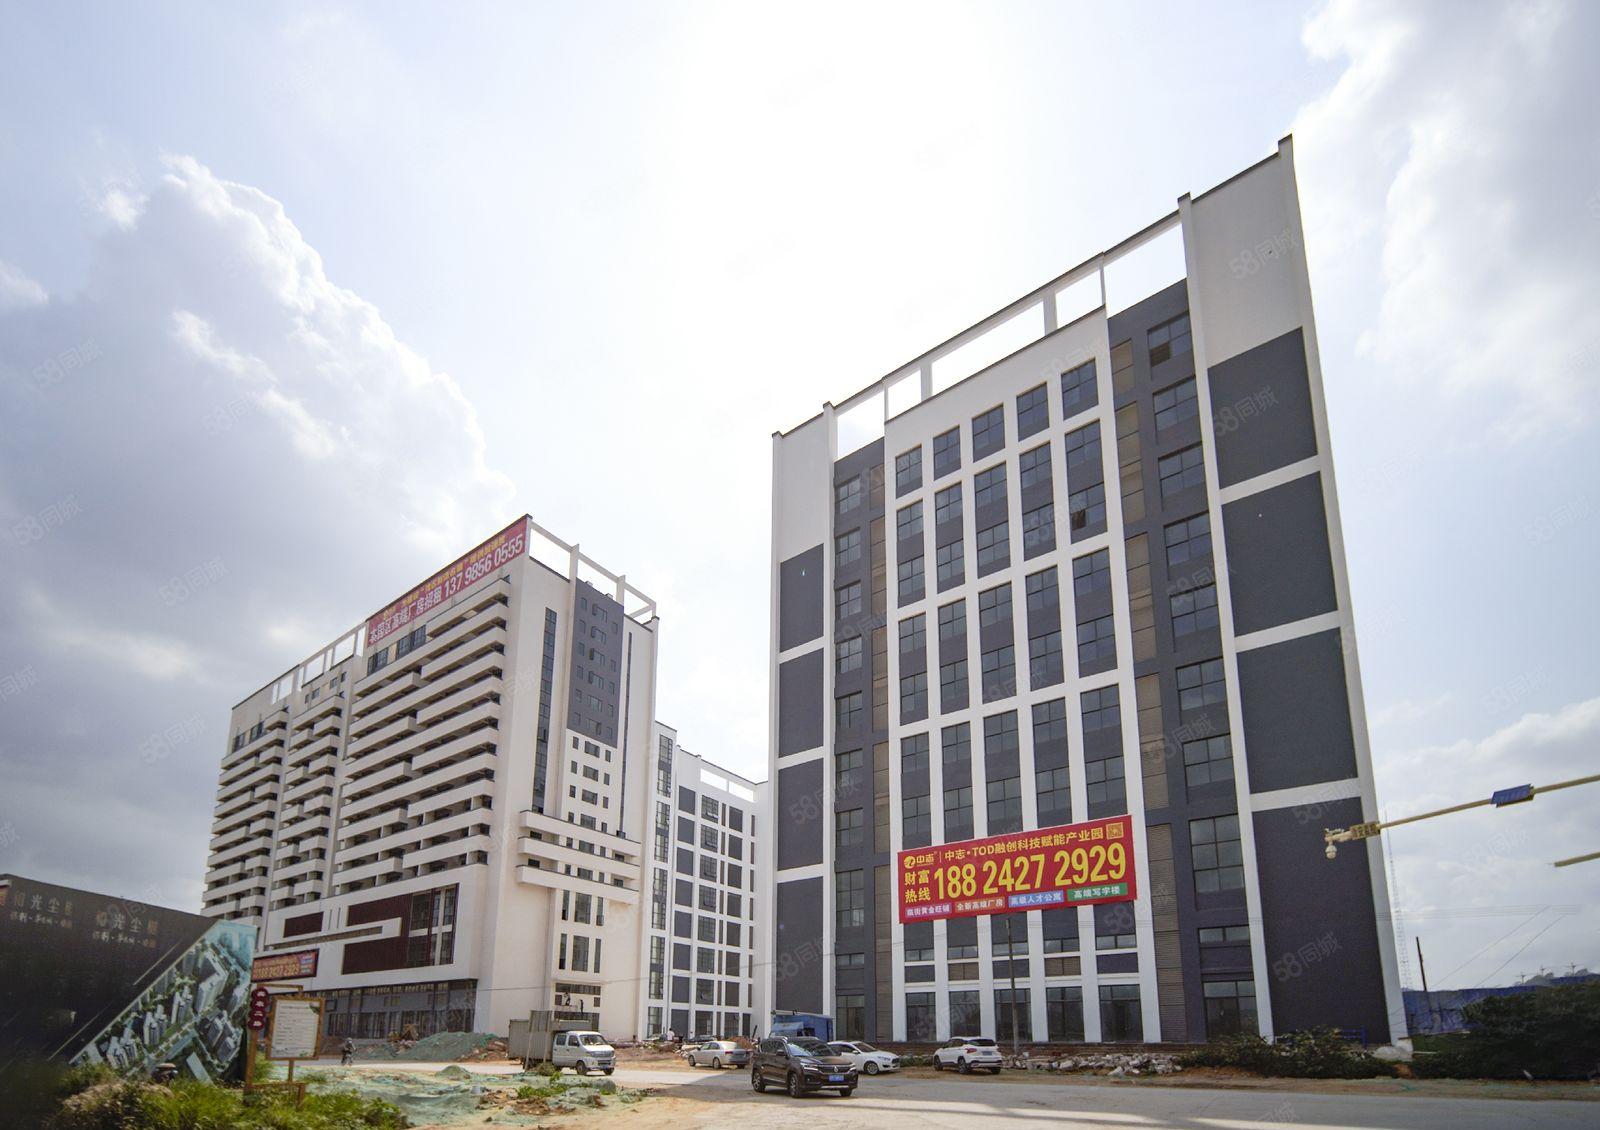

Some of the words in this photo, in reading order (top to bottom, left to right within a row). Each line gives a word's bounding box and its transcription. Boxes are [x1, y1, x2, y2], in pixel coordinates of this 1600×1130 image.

[444, 572, 463, 598] 137
[465, 554, 492, 585] 9856
[494, 533, 523, 567] 0555
[904, 869, 930, 885] 财富
[934, 863, 977, 899] 188
[982, 854, 1045, 894] 2427
[1054, 842, 1126, 886] 2929
[904, 887, 931, 903] 热线
